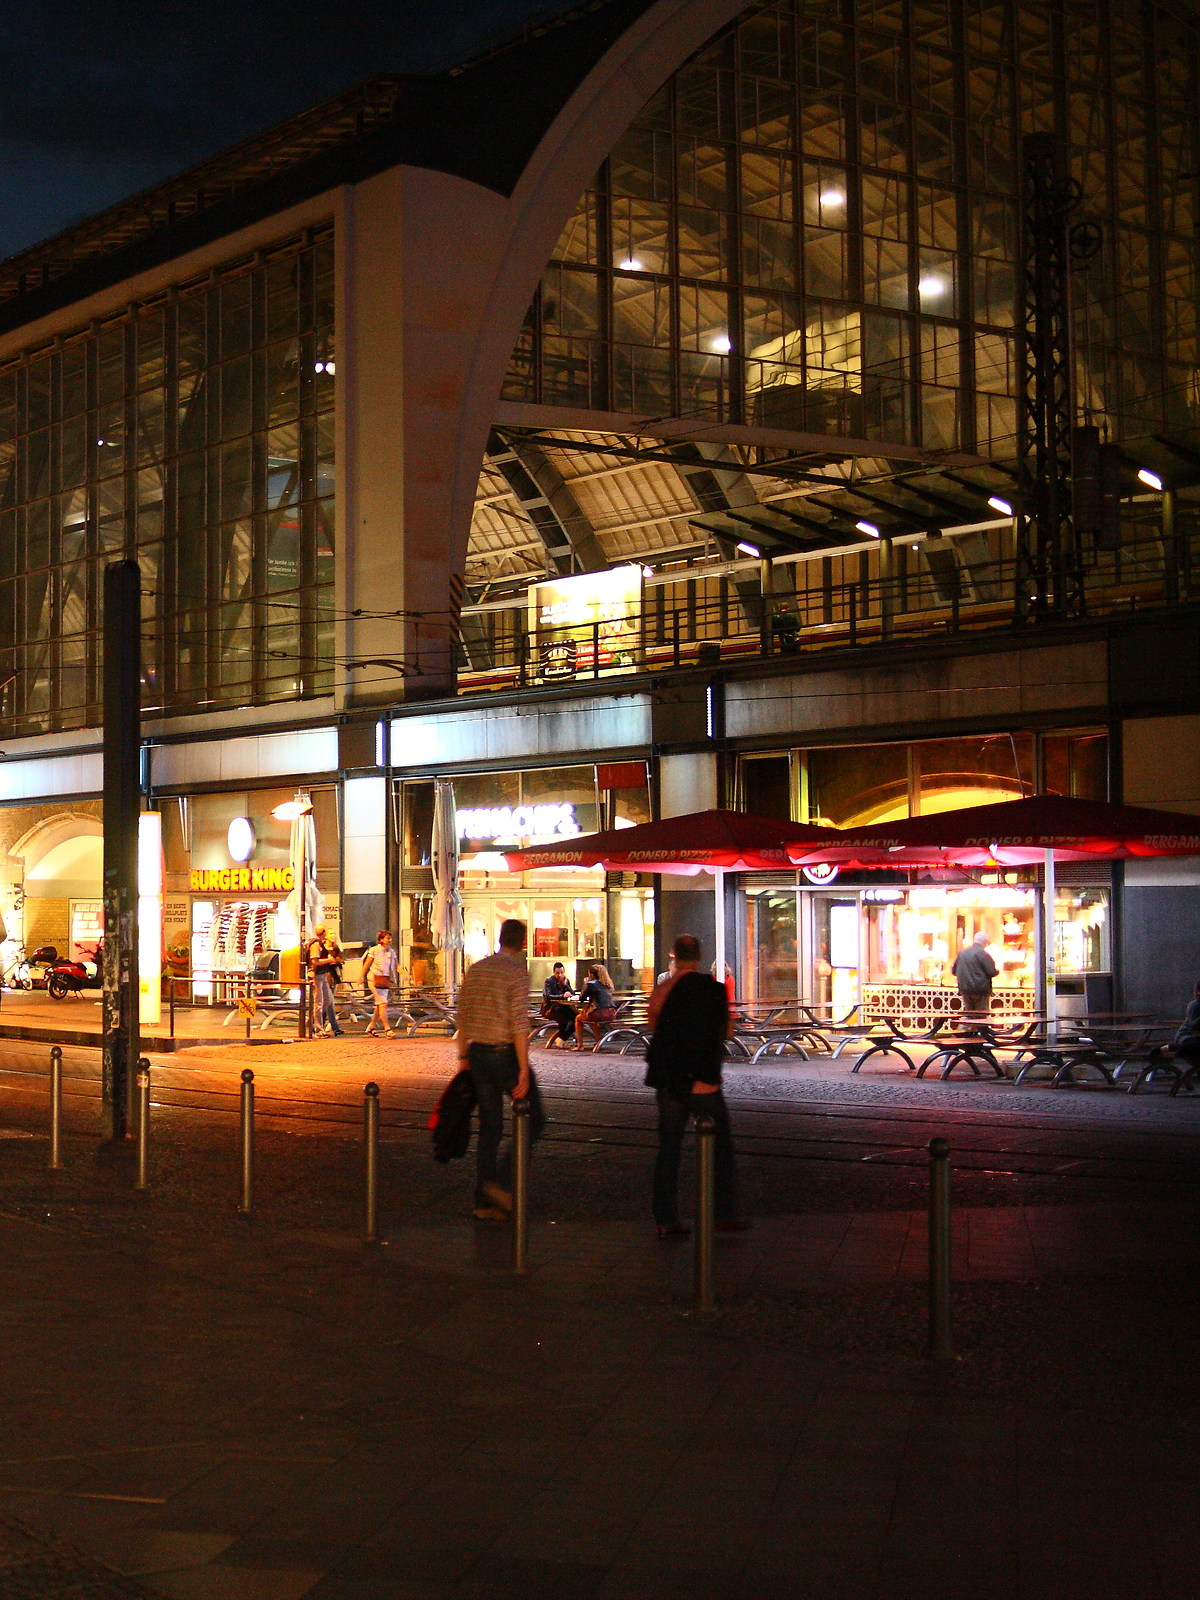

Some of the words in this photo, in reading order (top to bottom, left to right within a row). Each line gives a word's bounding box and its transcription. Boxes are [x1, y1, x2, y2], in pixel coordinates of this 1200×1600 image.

[523, 851, 583, 865] PERGAMON
[679, 849, 712, 861] PIZZA
[190, 867, 251, 891] BURGER
[252, 866, 294, 891] KING
